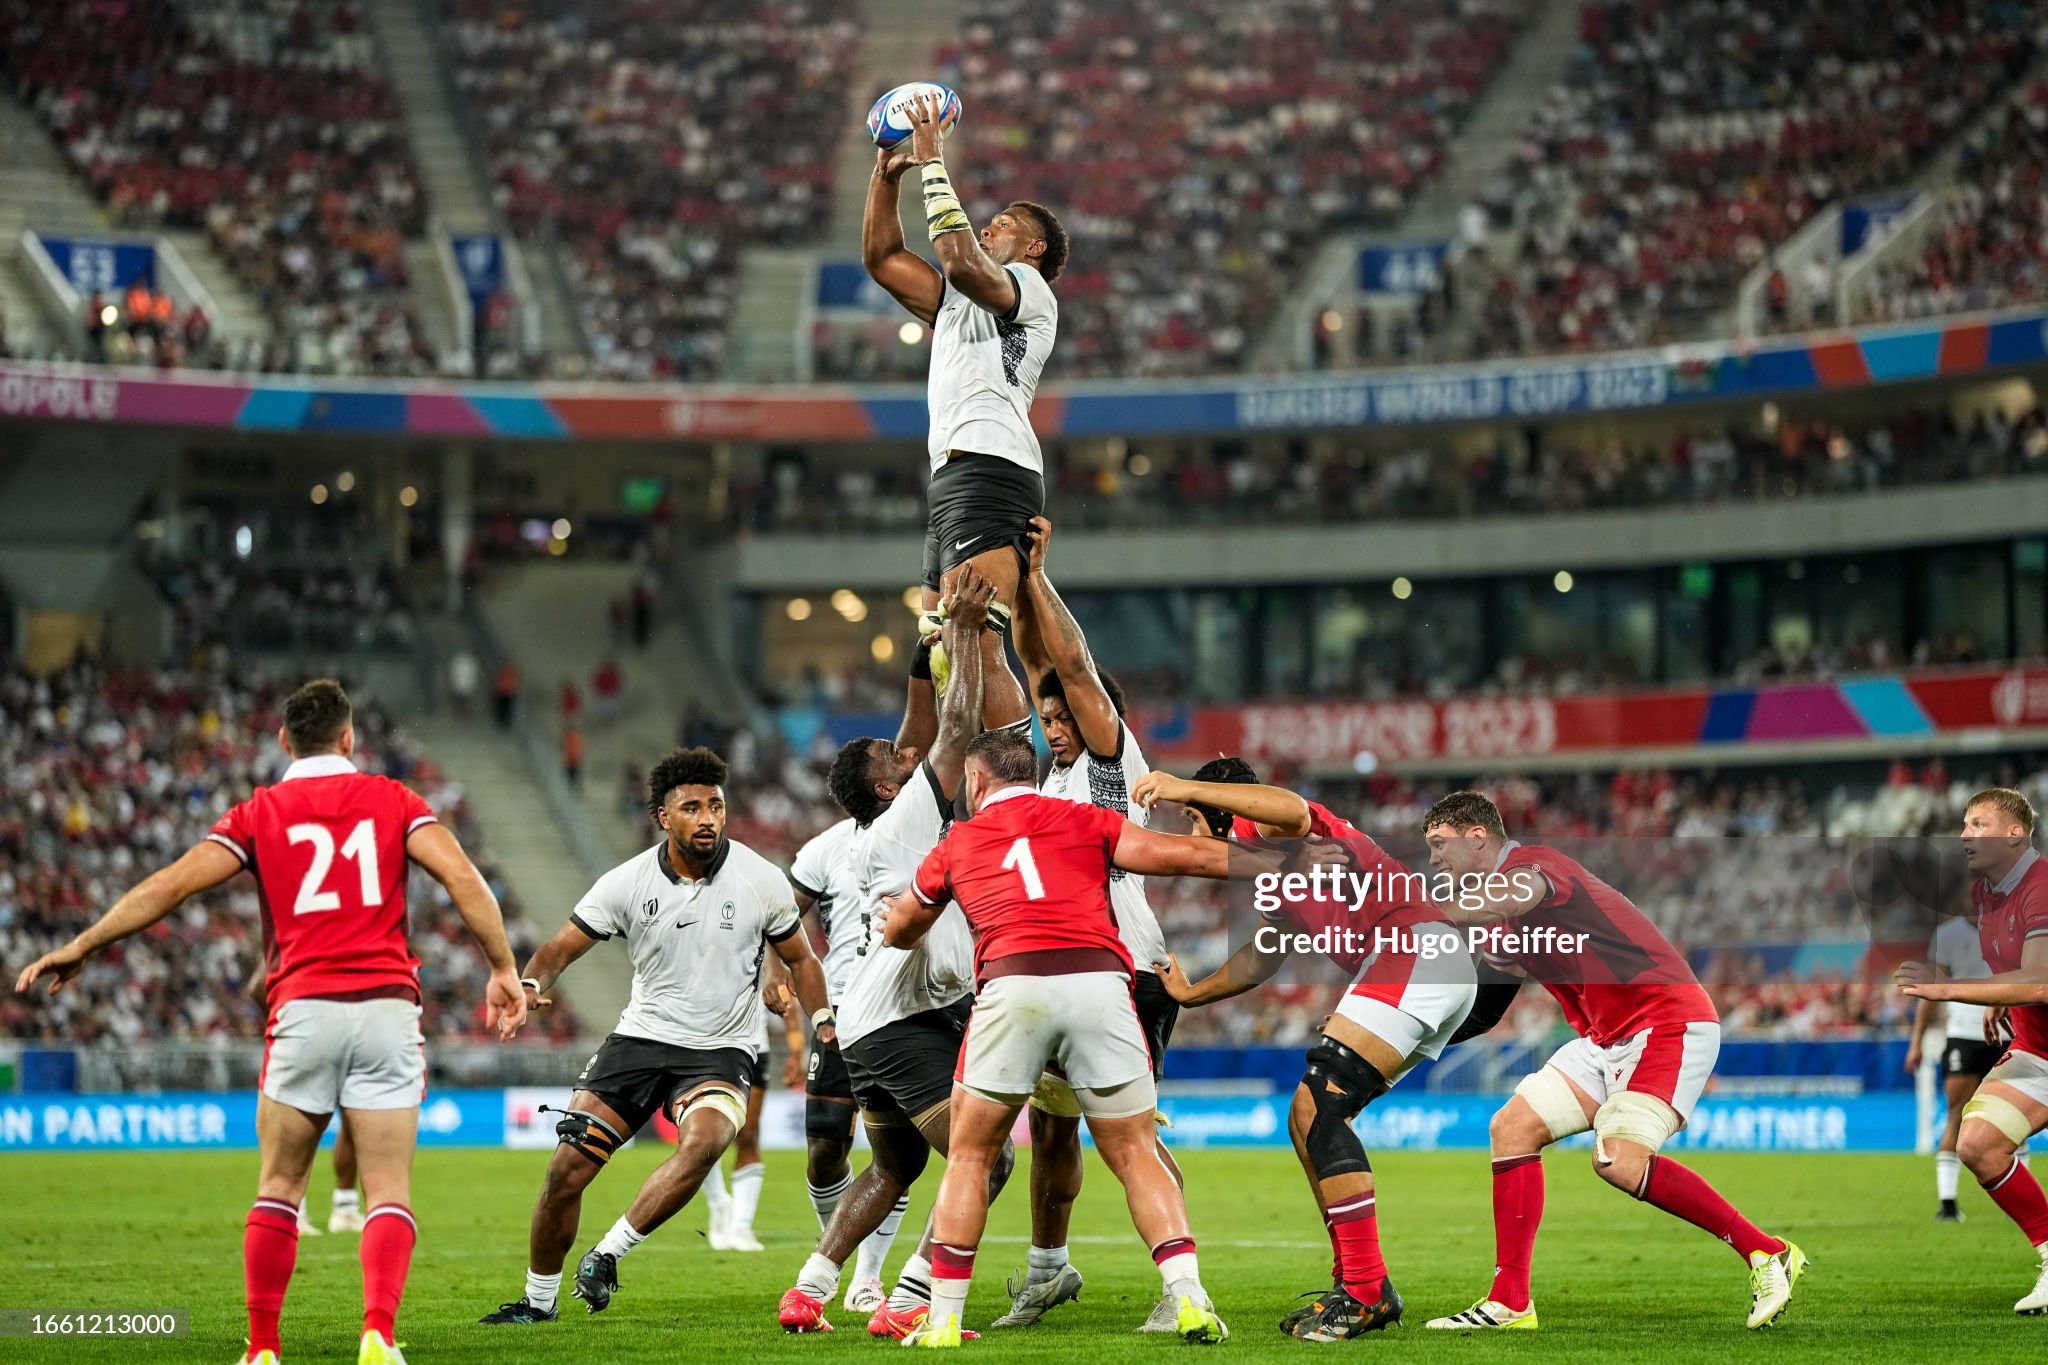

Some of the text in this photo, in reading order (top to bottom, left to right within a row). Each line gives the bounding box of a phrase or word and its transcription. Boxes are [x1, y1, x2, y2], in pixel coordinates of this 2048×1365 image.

[286, 818, 383, 916] 21
[1000, 836, 1046, 900] 1
[44, 1104, 226, 1144] PARTNER
[1687, 1106, 1847, 1148] PARTNER
